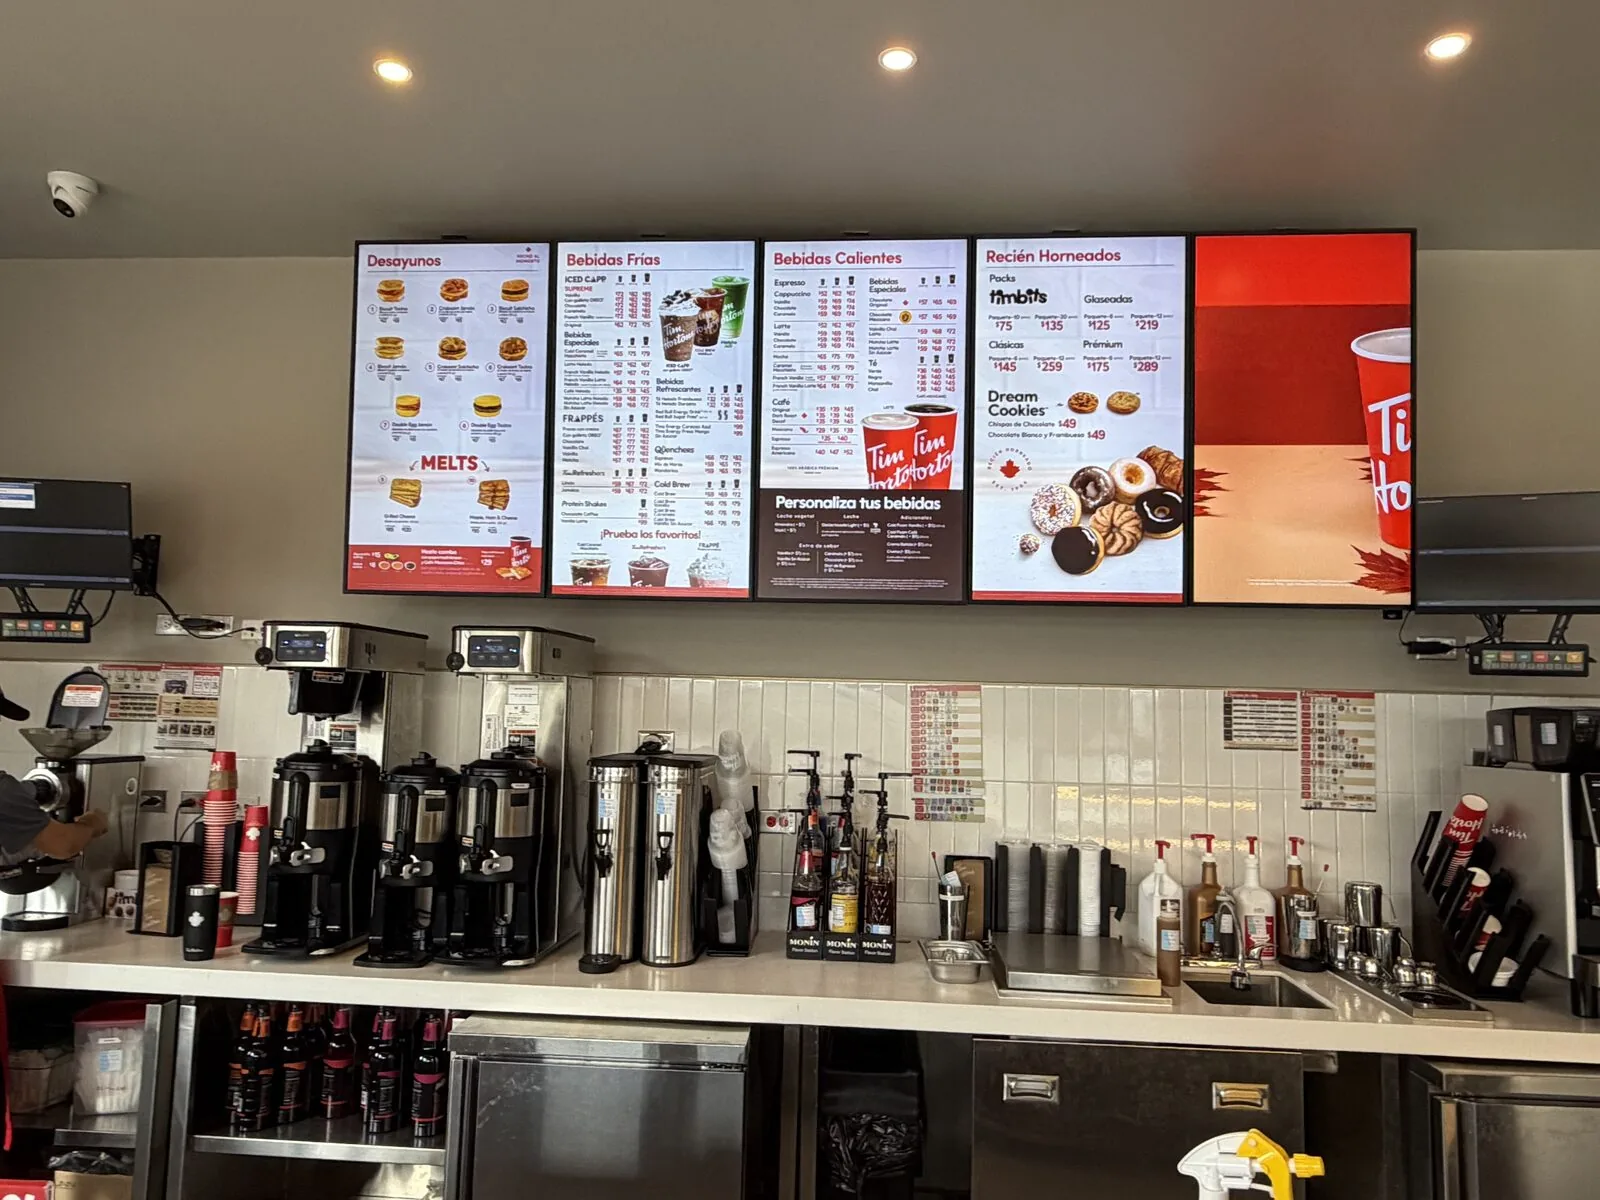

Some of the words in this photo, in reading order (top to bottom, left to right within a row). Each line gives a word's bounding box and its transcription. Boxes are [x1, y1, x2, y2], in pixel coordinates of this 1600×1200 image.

[567, 254, 623, 266] Bebidas
[627, 253, 660, 266] Frías
[774, 252, 831, 265] Bebidas
[835, 251, 902, 264] Calientes
[986, 250, 1034, 263] Recién
[1039, 249, 1121, 262] Horneados
[367, 255, 441, 270] Desayunos
[774, 279, 806, 287] Espresso
[989, 274, 1016, 282] Packs
[869, 286, 906, 294] Especiales
[989, 288, 1047, 304] timbits
[1084, 295, 1133, 303] Glaseadas
[663, 322, 682, 336] Tim
[996, 321, 1012, 331] $75
[1041, 320, 1063, 330] $135
[1088, 320, 1110, 330] $125
[1136, 320, 1159, 330] $219
[989, 340, 1024, 349] Clásicas
[1083, 340, 1122, 348] Prémium
[994, 362, 1017, 371] $145
[1037, 362, 1062, 371] $259
[1088, 362, 1110, 371] $175
[1134, 362, 1158, 371] $289
[988, 390, 1038, 402] Dream
[988, 404, 1045, 416] Cookies
[563, 412, 604, 422] FRAPPÉS
[1058, 419, 1077, 428] $49
[1087, 430, 1106, 440] $49
[914, 429, 946, 456] Tim
[867, 443, 904, 470] Tim
[421, 455, 478, 471] MELTS
[776, 496, 856, 509] Personaliza
[859, 497, 881, 509] tus
[884, 496, 941, 509] bebidas
[600, 530, 638, 540] ¡Prueba
[640, 530, 653, 539] los
[656, 530, 701, 539] favoritos!
[1449, 829, 1474, 844] Tim
[789, 936, 820, 946] MONIN
[826, 938, 856, 948] MONIN
[862, 939, 893, 949] MONIN
